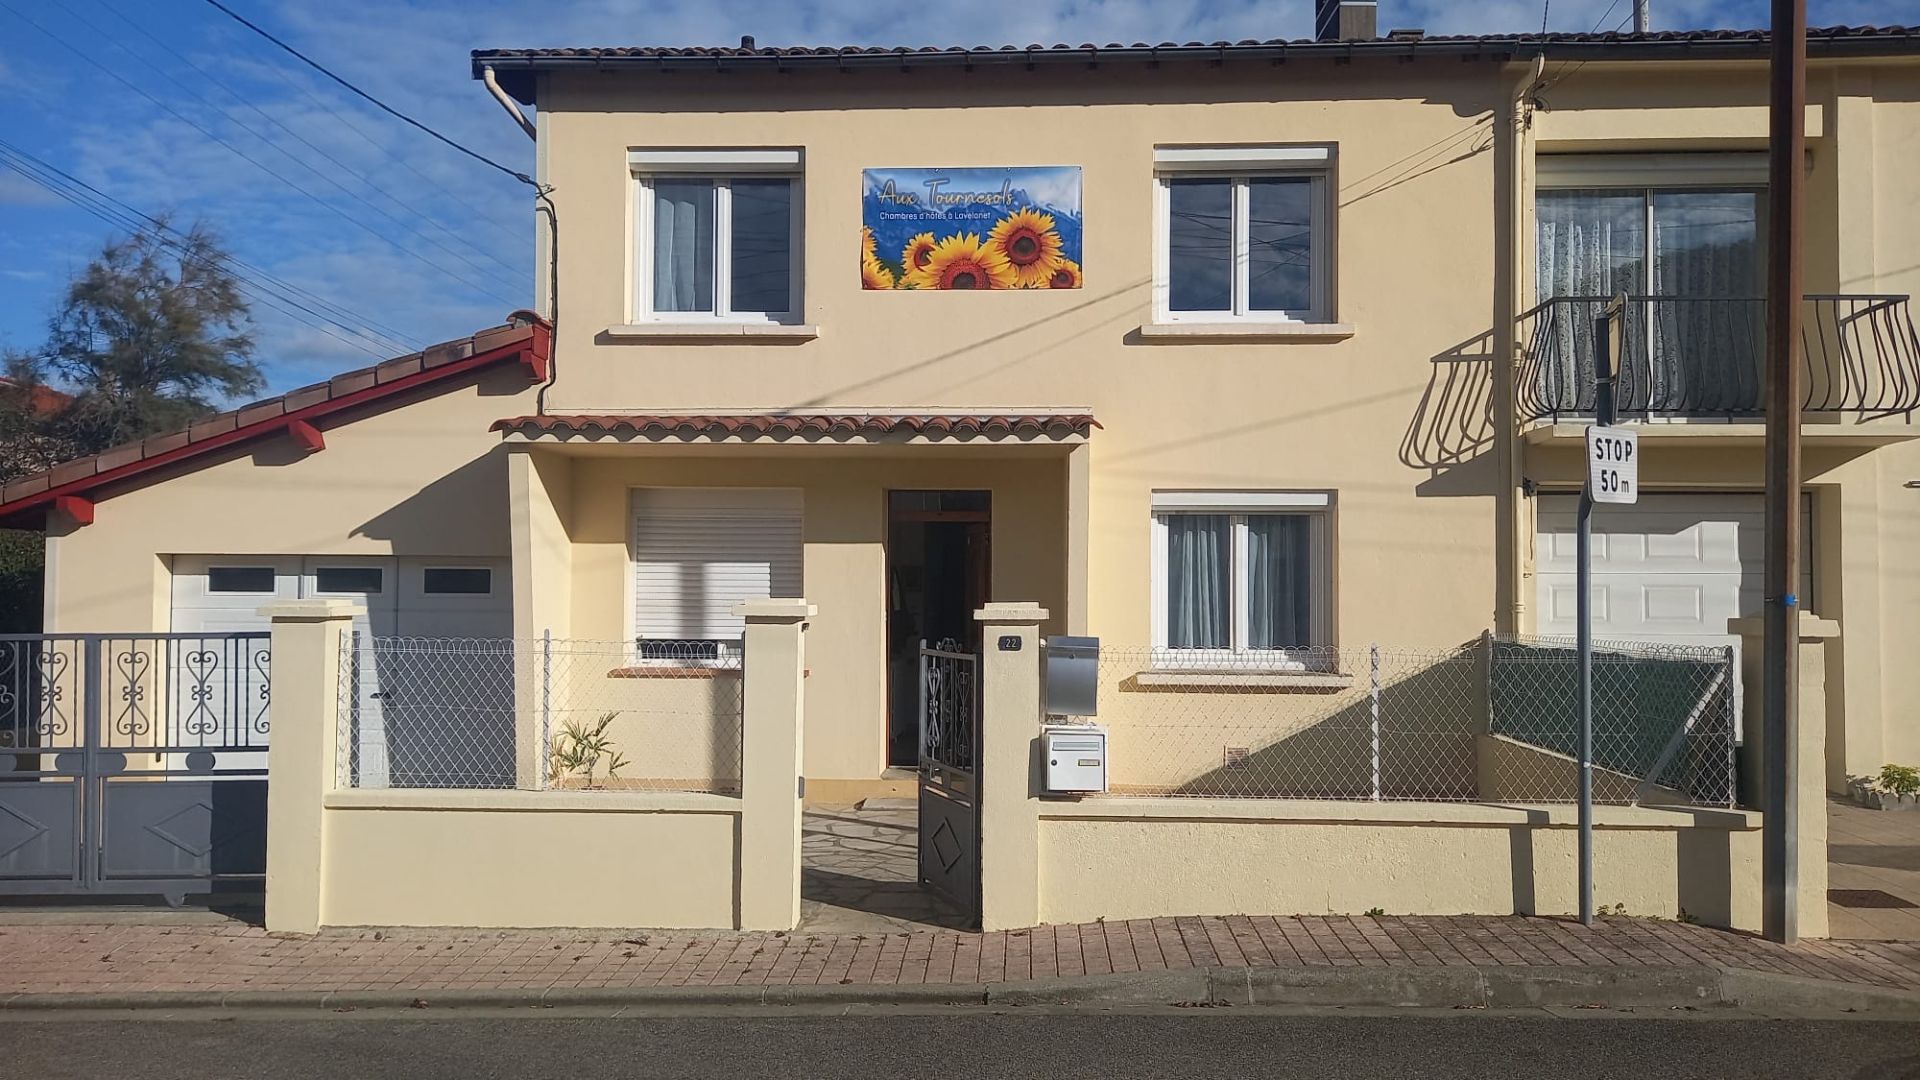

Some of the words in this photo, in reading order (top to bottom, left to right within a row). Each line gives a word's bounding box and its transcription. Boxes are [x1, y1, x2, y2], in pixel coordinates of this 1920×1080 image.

[879, 180, 917, 206] Aux
[924, 179, 1014, 207] Tournesols
[879, 211, 918, 220] Chambres
[954, 211, 991, 220] Lavelanet
[1595, 437, 1632, 462] STOP
[1601, 469, 1618, 492] 50
[1621, 480, 1630, 493] m
[1005, 638, 1017, 648] 22
